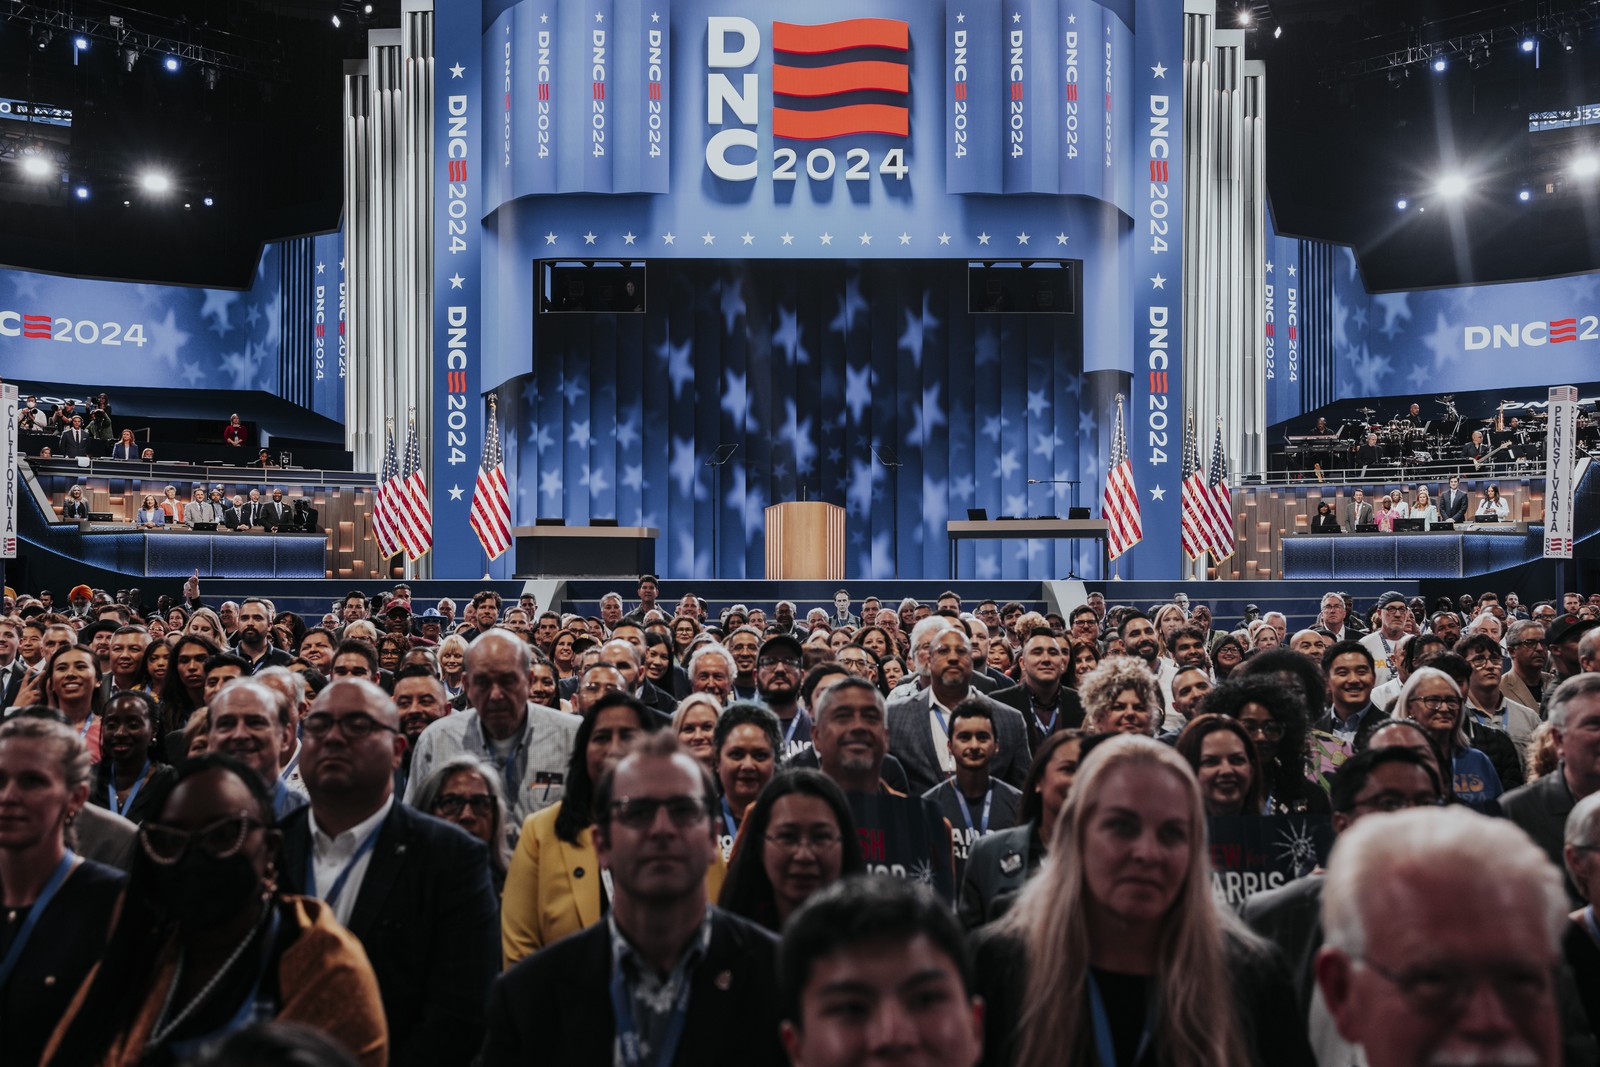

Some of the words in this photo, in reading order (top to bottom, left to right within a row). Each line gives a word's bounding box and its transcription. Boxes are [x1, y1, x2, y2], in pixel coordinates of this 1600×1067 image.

[538, 31, 550, 82] DNC
[592, 29, 606, 82] DNC
[649, 29, 661, 82] DNC
[954, 30, 967, 82] DNC
[1010, 30, 1023, 82] DNC
[1066, 31, 1078, 83] DNC
[448, 95, 467, 159] DNC
[706, 16, 760, 181] DNC
[1150, 95, 1169, 159] DNC
[538, 102, 549, 159] 2024
[592, 101, 605, 158] 2024
[649, 101, 661, 158] 2024
[954, 101, 967, 159] 2024
[1010, 101, 1023, 159] 2024
[1066, 102, 1077, 160] 2024
[772, 148, 909, 181] 2024
[448, 183, 467, 254] 2024
[1150, 183, 1169, 254] 2024
[53, 317, 148, 347] 2024
[316, 285, 325, 324] DNC
[1265, 284, 1274, 323] DNC
[1288, 288, 1297, 326] DNC
[315, 338, 324, 381] 2024
[447, 306, 467, 370] DNC
[1149, 306, 1168, 370] DNC
[1266, 337, 1274, 380] 2024
[1288, 340, 1297, 382] 2024
[1464, 321, 1547, 350] DNC
[447, 395, 467, 466] 2024
[1149, 395, 1168, 466] 2024
[6, 404, 15, 533] CALIFORNIA
[1550, 405, 1562, 533] PENNSYLVANIA
